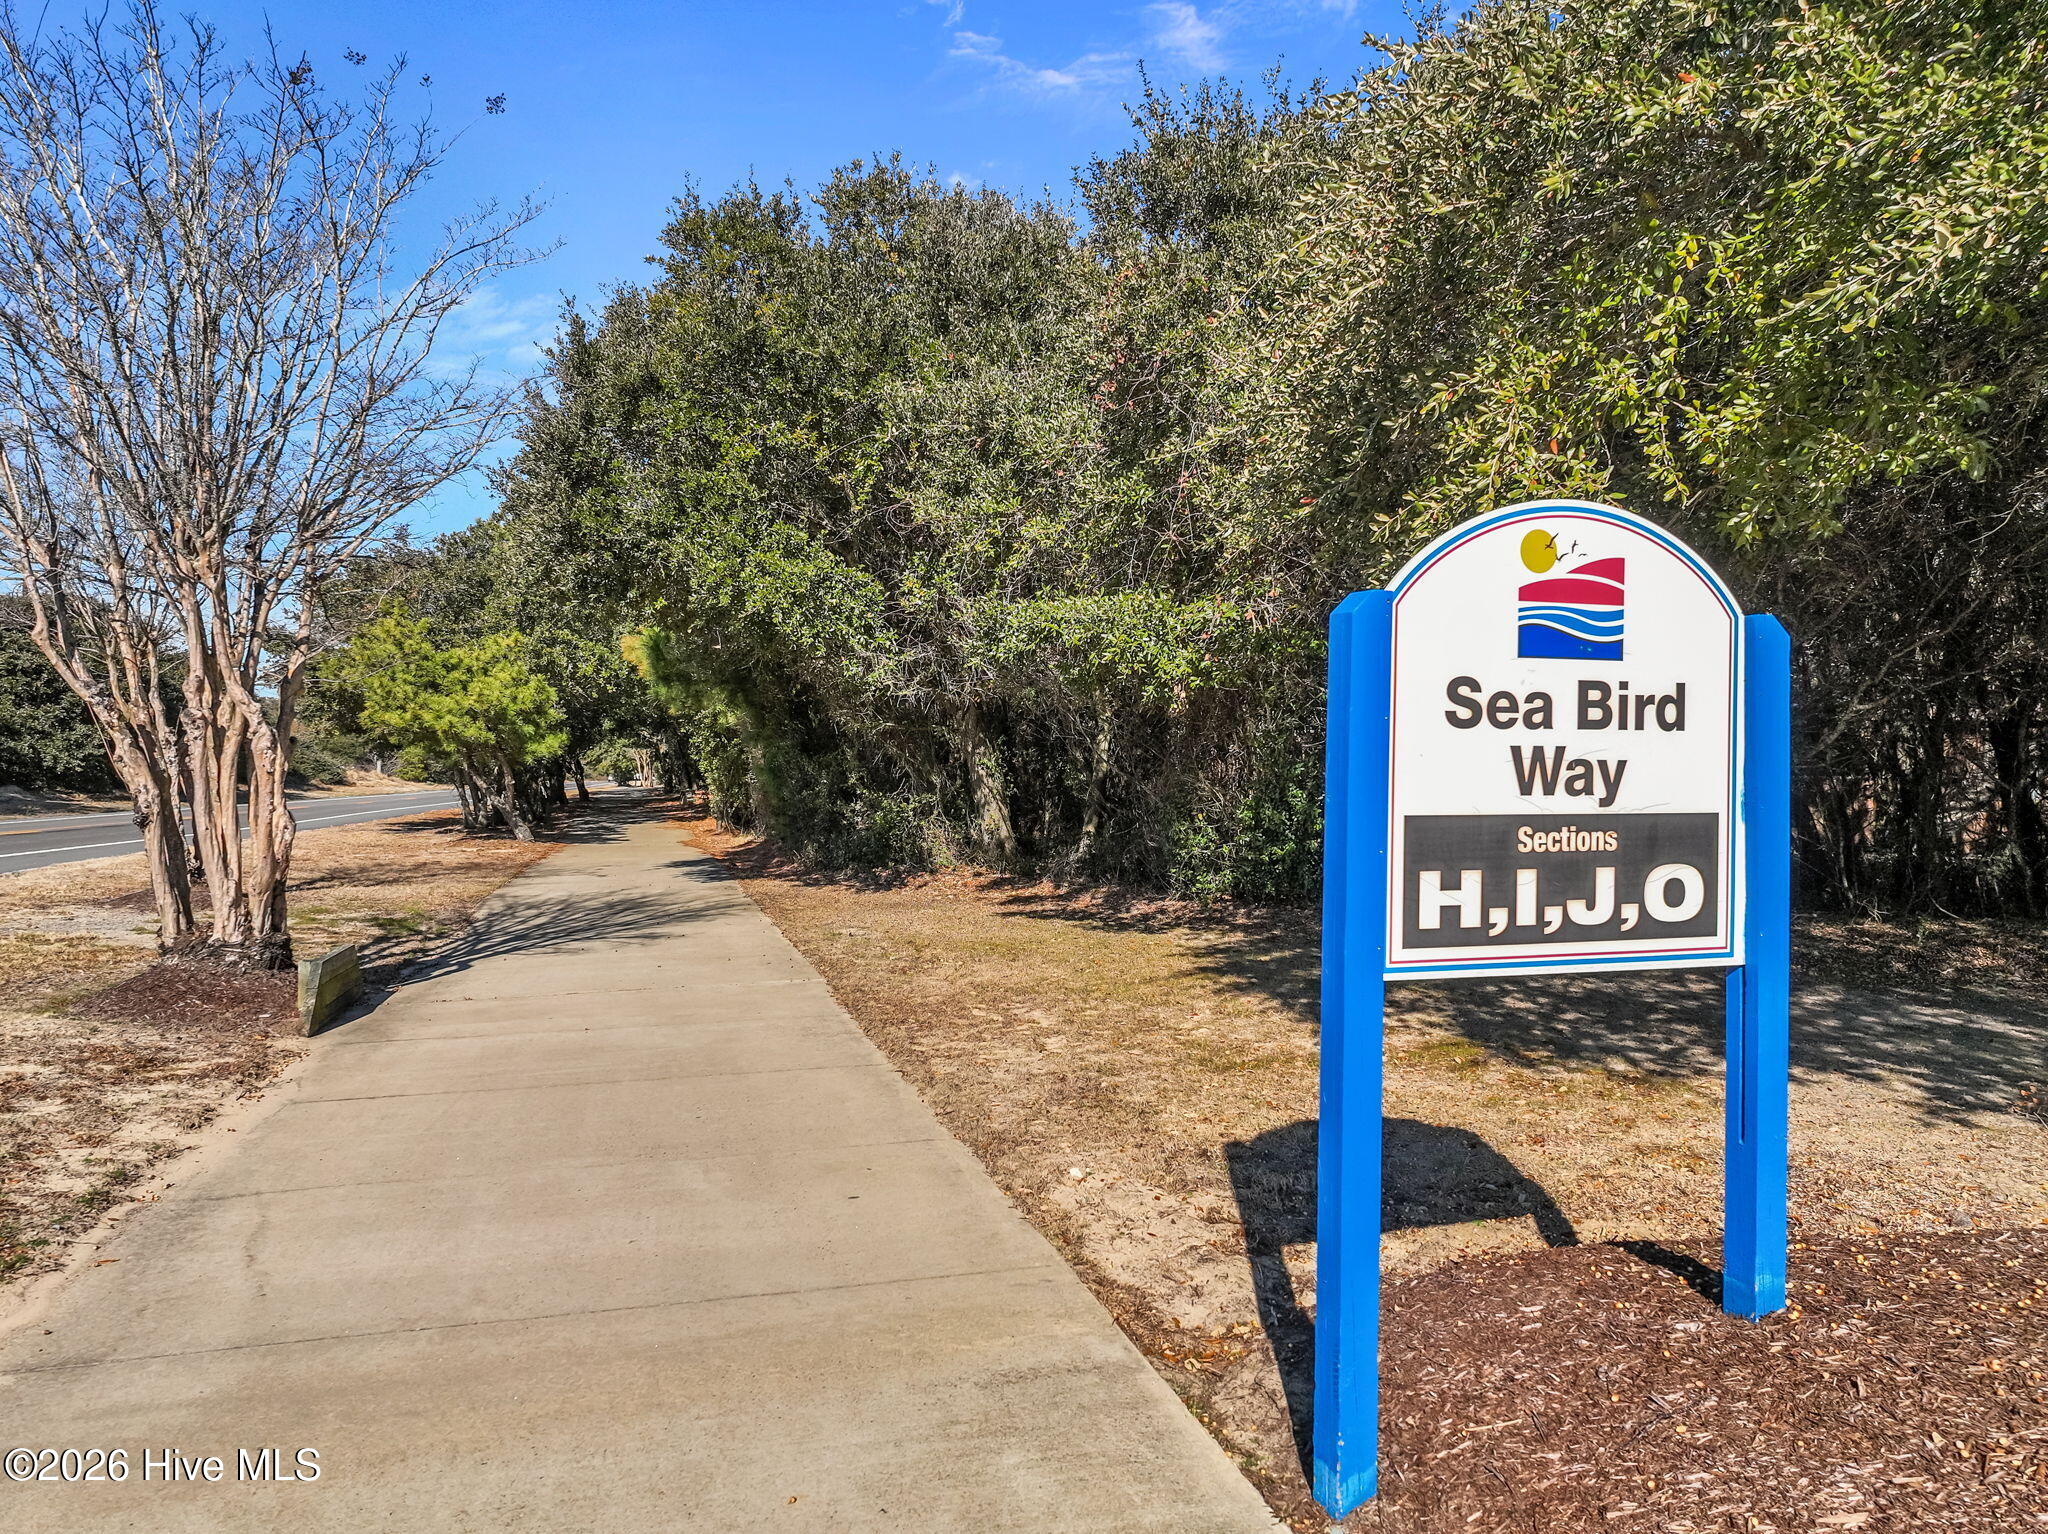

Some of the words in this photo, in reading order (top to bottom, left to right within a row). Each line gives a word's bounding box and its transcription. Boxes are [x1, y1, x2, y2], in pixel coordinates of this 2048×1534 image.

[1444, 675, 1553, 730] Sea
[1576, 679, 1687, 732] Bird
[1510, 745, 1628, 808] Way
[1517, 825, 1618, 853] Sections
[1417, 863, 1705, 937] H,I,J,O
